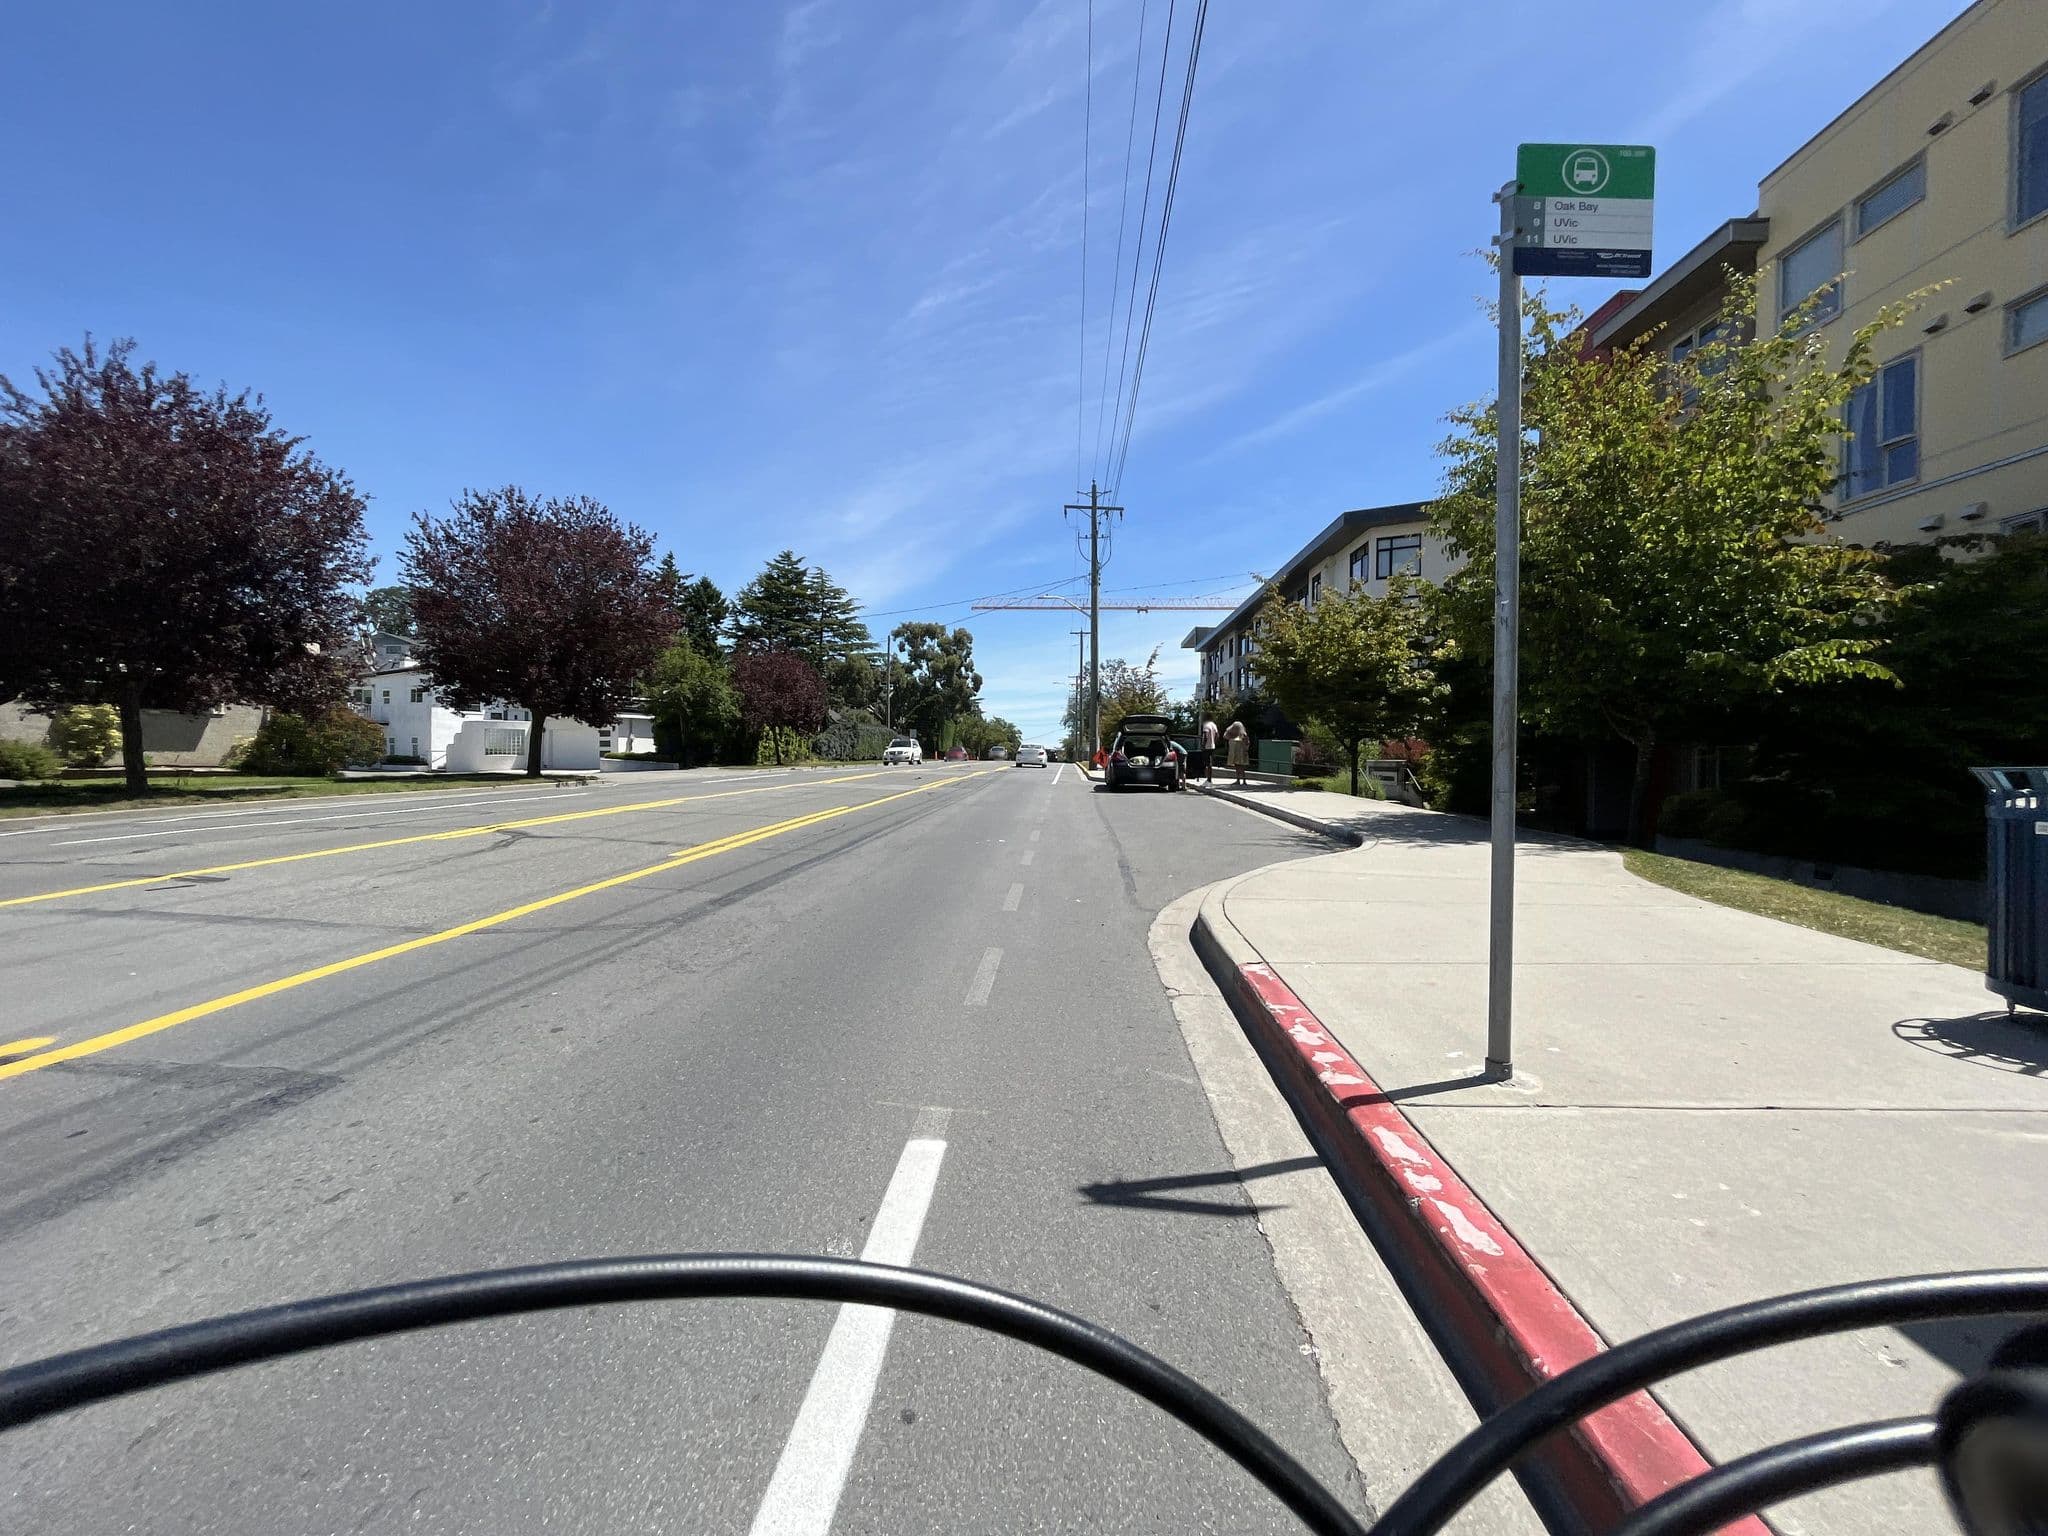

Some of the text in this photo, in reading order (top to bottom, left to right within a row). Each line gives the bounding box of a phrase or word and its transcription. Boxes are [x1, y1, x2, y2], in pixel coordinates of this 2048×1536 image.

[1533, 201, 1599, 213] 8 Oak Bay
[1554, 218, 1579, 228] UVic
[1526, 234, 1578, 244] 11 UVic
